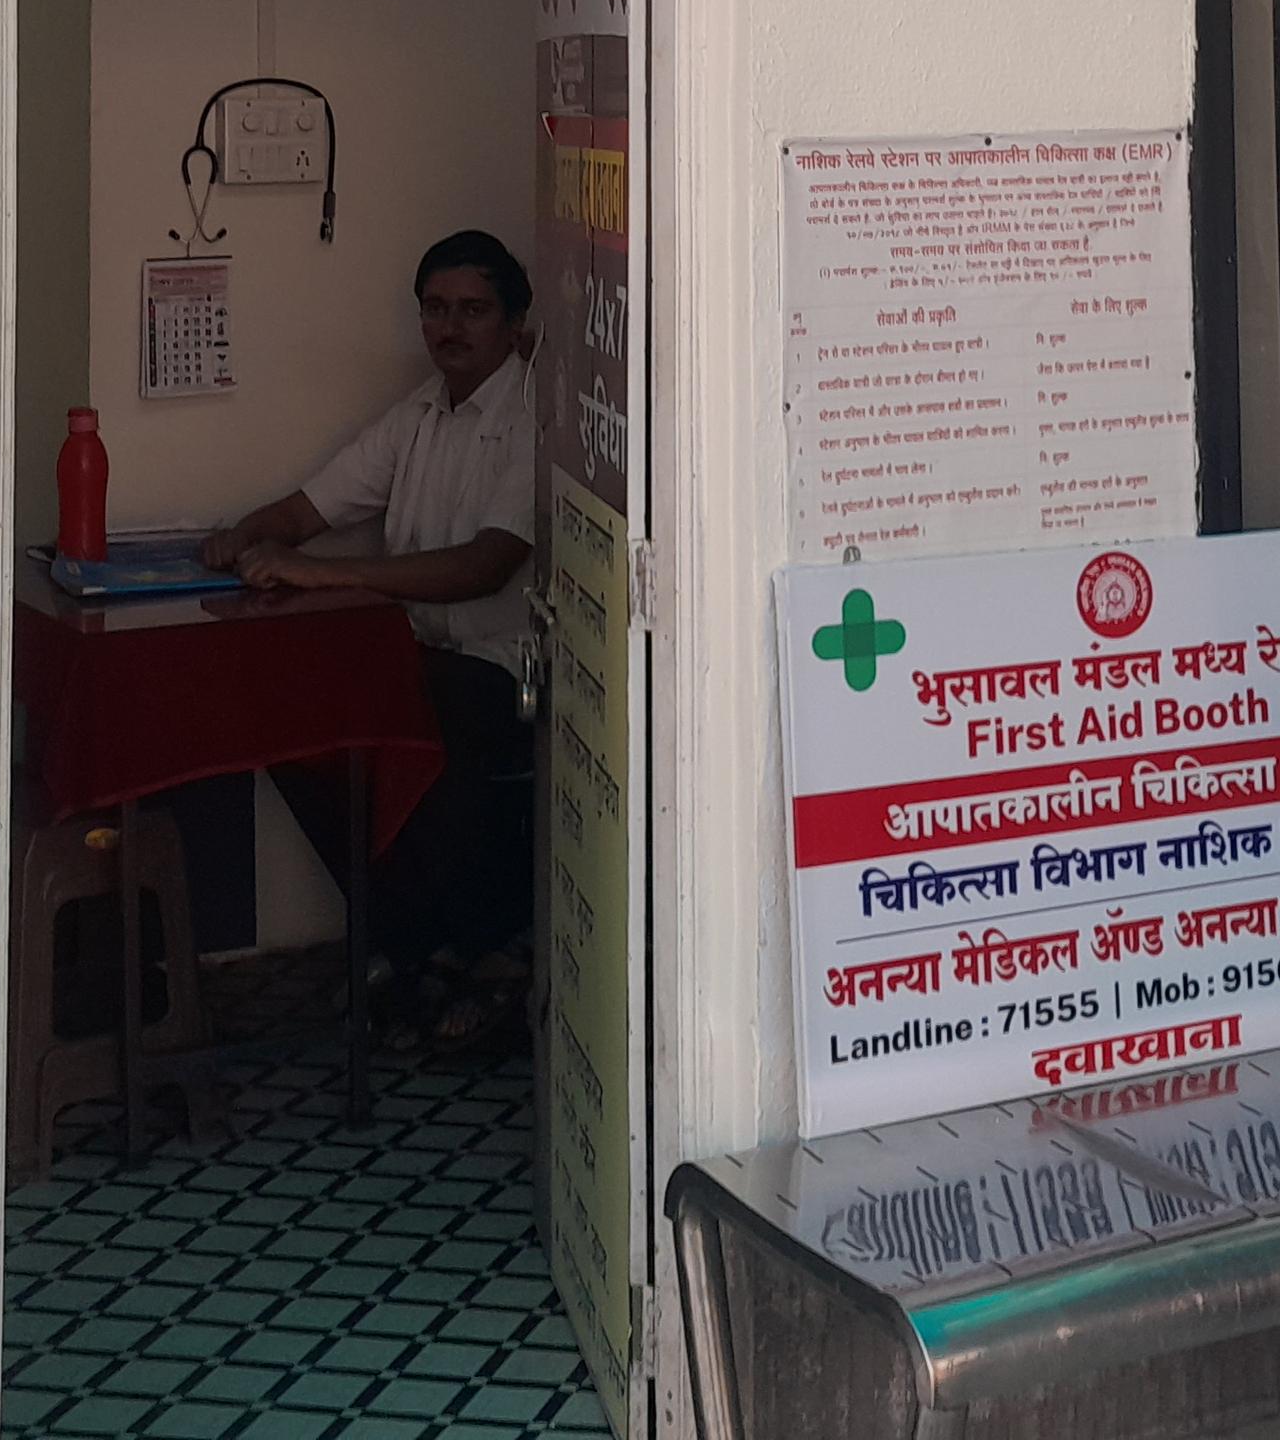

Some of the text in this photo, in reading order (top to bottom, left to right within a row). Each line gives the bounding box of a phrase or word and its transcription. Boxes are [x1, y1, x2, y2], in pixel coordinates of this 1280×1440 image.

[795, 150, 841, 170] नाशिक
[846, 147, 875, 168] रेलवे
[880, 146, 919, 168] स्टेशन
[924, 151, 941, 166] पर
[947, 142, 1030, 165] आपातकालीन
[1035, 143, 1089, 163] चिकित्सा
[1093, 146, 1116, 161] कक्ष
[912, 659, 1061, 726] भुसावल
[1071, 641, 1162, 690] मंडल
[1172, 641, 1247, 679] मध्य
[967, 687, 1269, 758] First Aid Booth
[884, 770, 1122, 838] आपातकालीन
[1130, 757, 1276, 808] चिकित्सा
[858, 860, 1020, 917] चिकित्सा
[1030, 842, 1147, 891] विभाग
[1156, 821, 1272, 869] नाशिक
[823, 951, 942, 1006] अनन्या
[951, 928, 1079, 985] मेडिकल
[1175, 897, 1278, 947] अनन्या
[997, 989, 1099, 1033] 71555
[1031, 1014, 1242, 1084] दवाखाना
